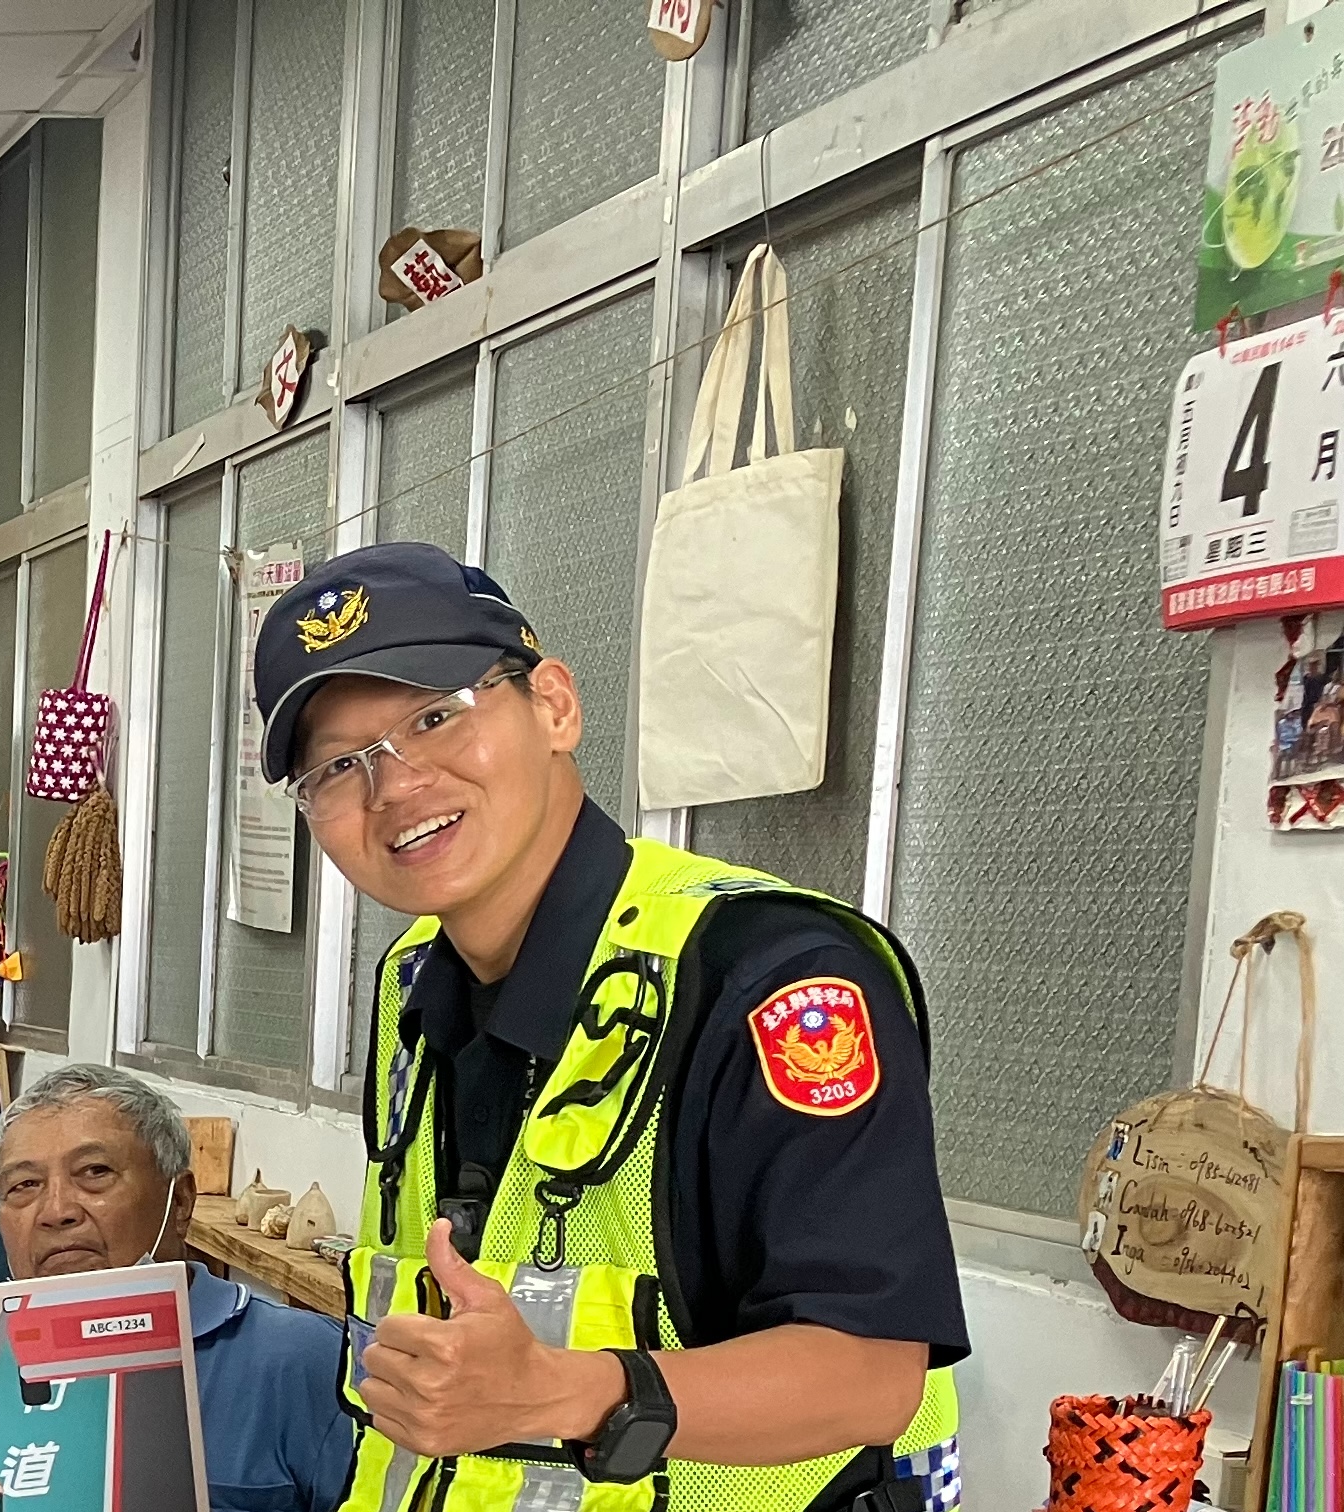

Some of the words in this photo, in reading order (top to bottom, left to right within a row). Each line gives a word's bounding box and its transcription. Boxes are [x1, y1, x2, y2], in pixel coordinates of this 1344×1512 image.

[1220, 360, 1283, 517] 4
[1312, 429, 1340, 482] 月
[1204, 530, 1267, 564] 星期三
[810, 1081, 856, 1104] 3203
[89, 1317, 146, 1335] ABC-1234
[0, 1441, 60, 1499] 道
